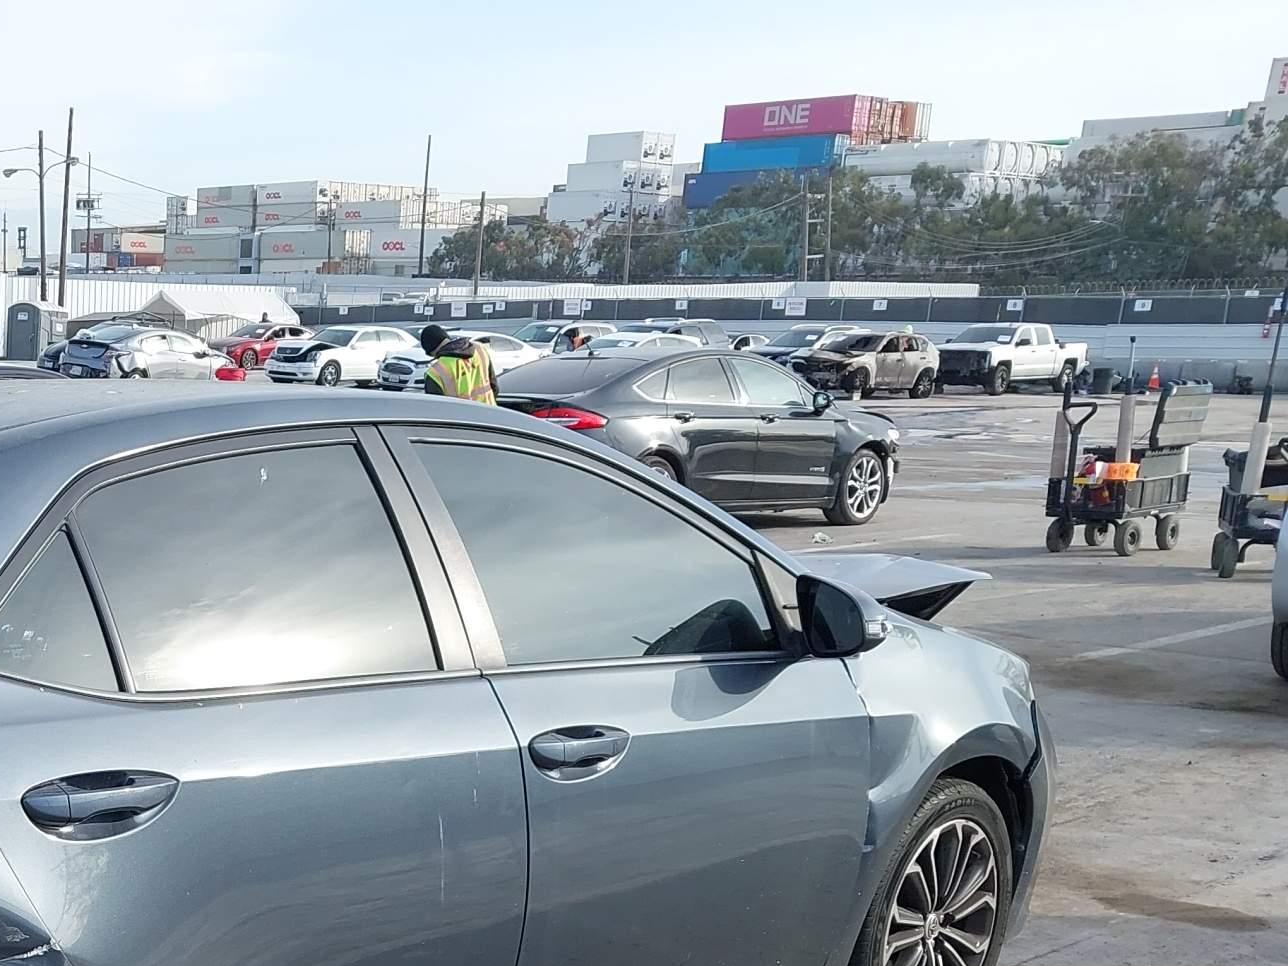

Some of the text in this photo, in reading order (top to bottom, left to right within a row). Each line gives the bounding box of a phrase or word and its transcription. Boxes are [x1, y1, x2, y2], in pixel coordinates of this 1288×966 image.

[764, 104, 810, 126] ONE
[344, 211, 362, 219] OOCL
[272, 244, 294, 253] OOCL
[382, 241, 406, 251] OOCL
